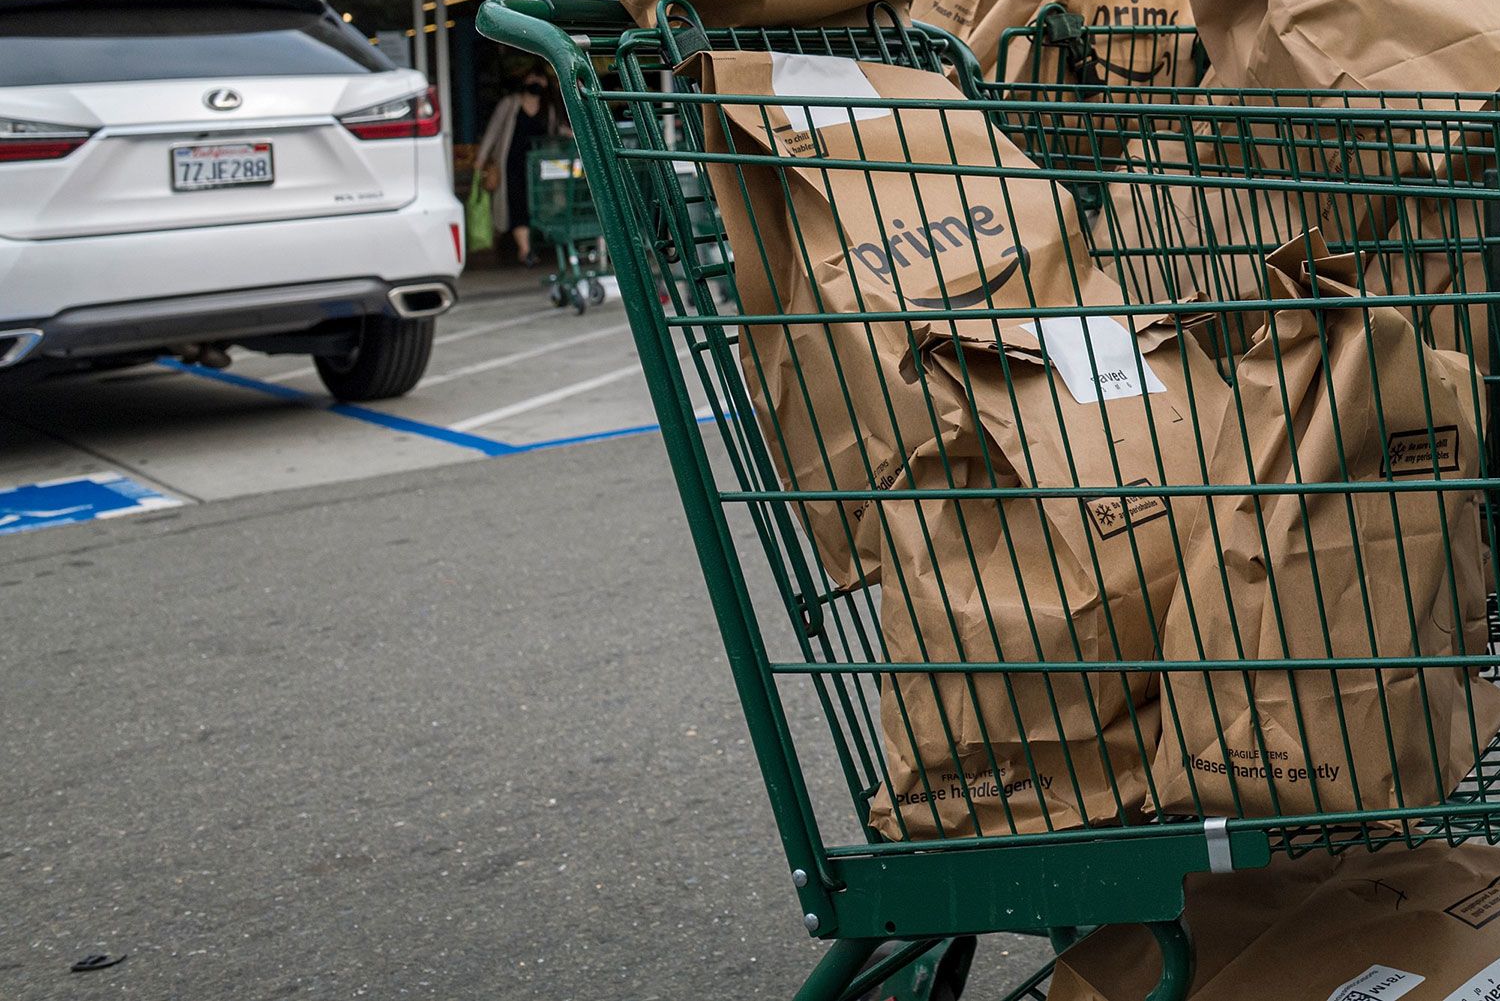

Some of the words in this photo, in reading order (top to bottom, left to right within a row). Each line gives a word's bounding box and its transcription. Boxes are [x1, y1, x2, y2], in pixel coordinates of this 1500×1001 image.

[794, 132, 810, 142] chill
[851, 205, 1005, 285] prime
[1004, 774, 1053, 798] genly
[1369, 973, 1406, 995] 781M
